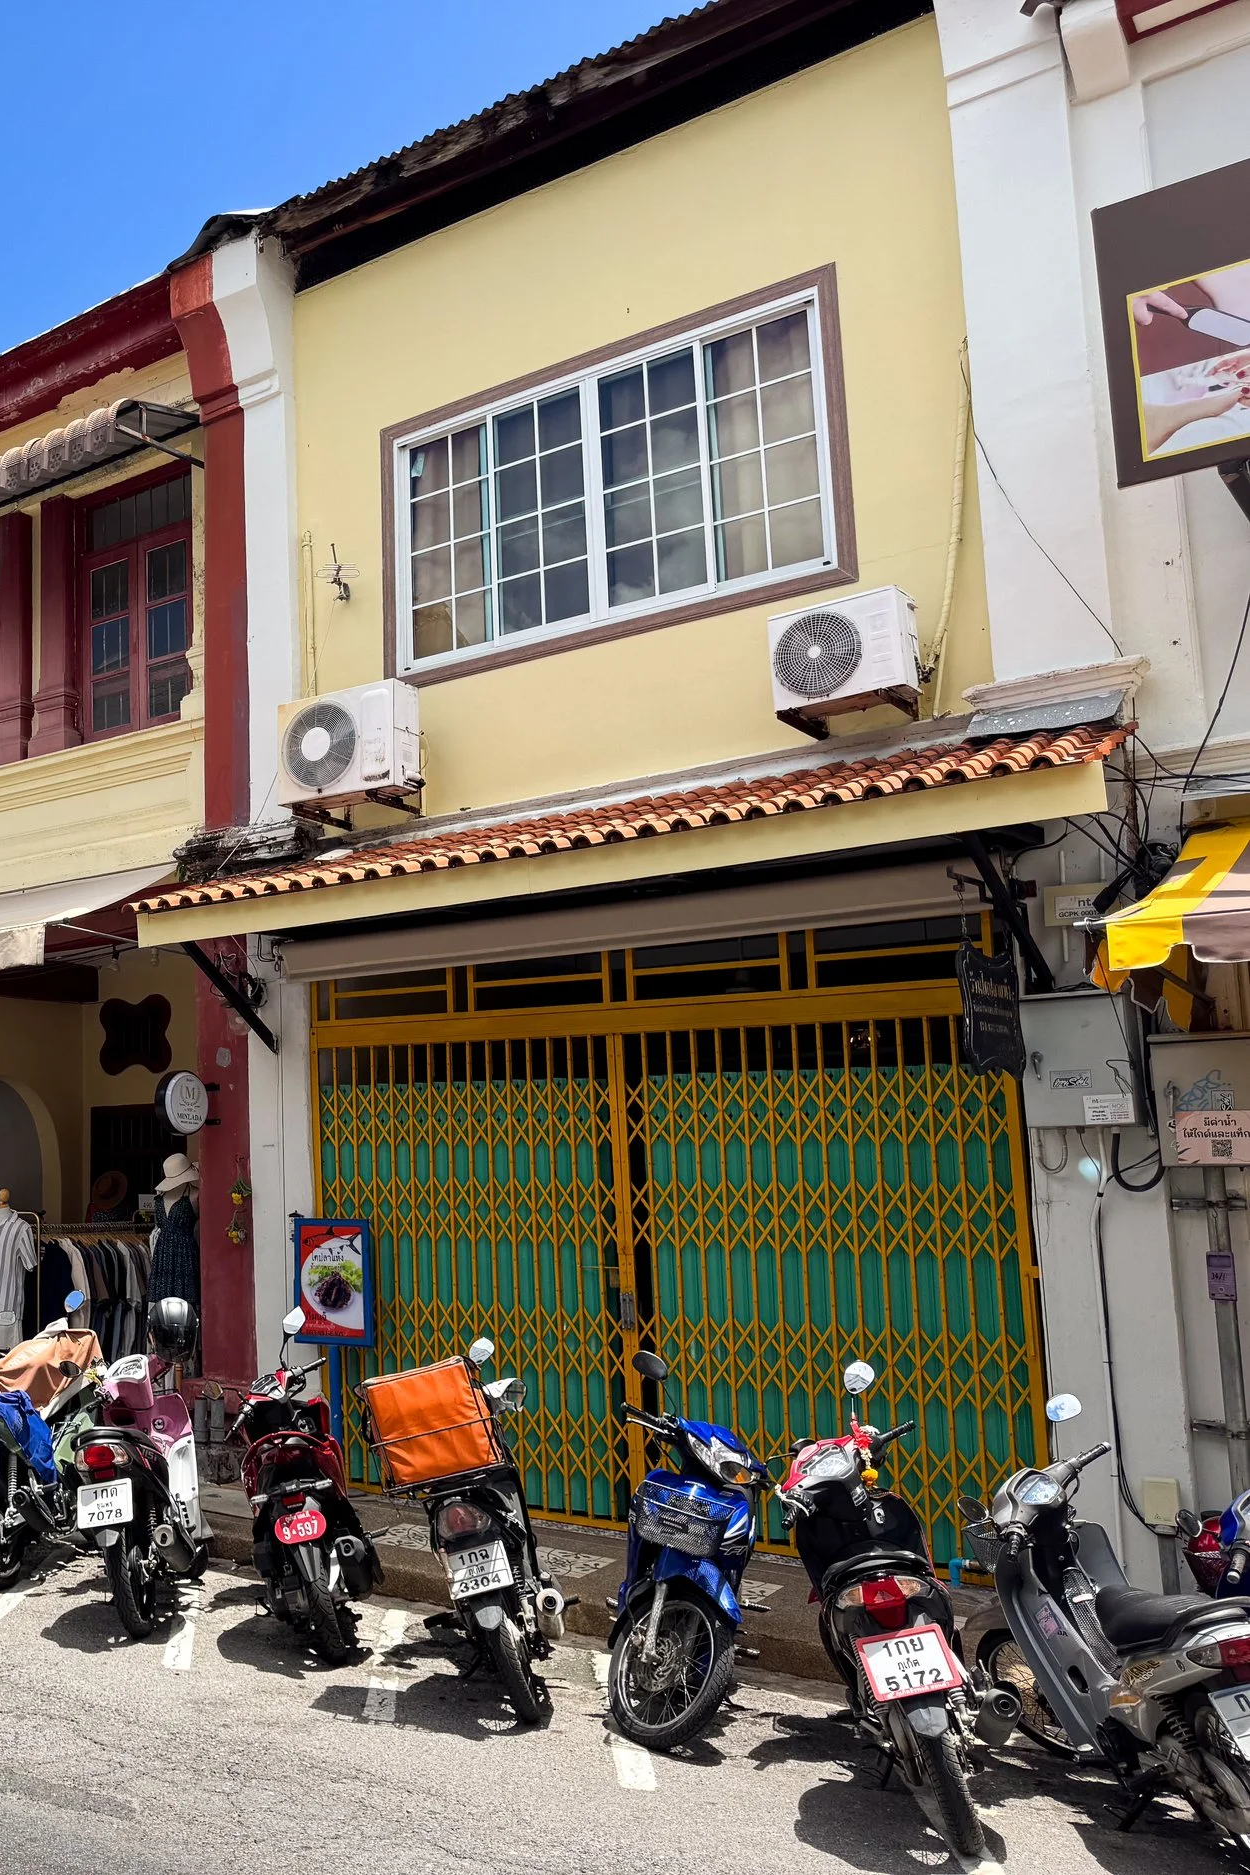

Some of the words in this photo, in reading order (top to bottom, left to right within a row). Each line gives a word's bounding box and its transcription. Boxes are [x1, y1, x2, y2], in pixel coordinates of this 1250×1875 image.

[185, 1086, 195, 1099] M
[88, 1508, 123, 1522] 7078
[459, 1573, 501, 1593] 3304
[882, 1637, 924, 1657] 1กย
[897, 1657, 920, 1672] ภูเก็ต
[885, 1668, 944, 1691] 5172
